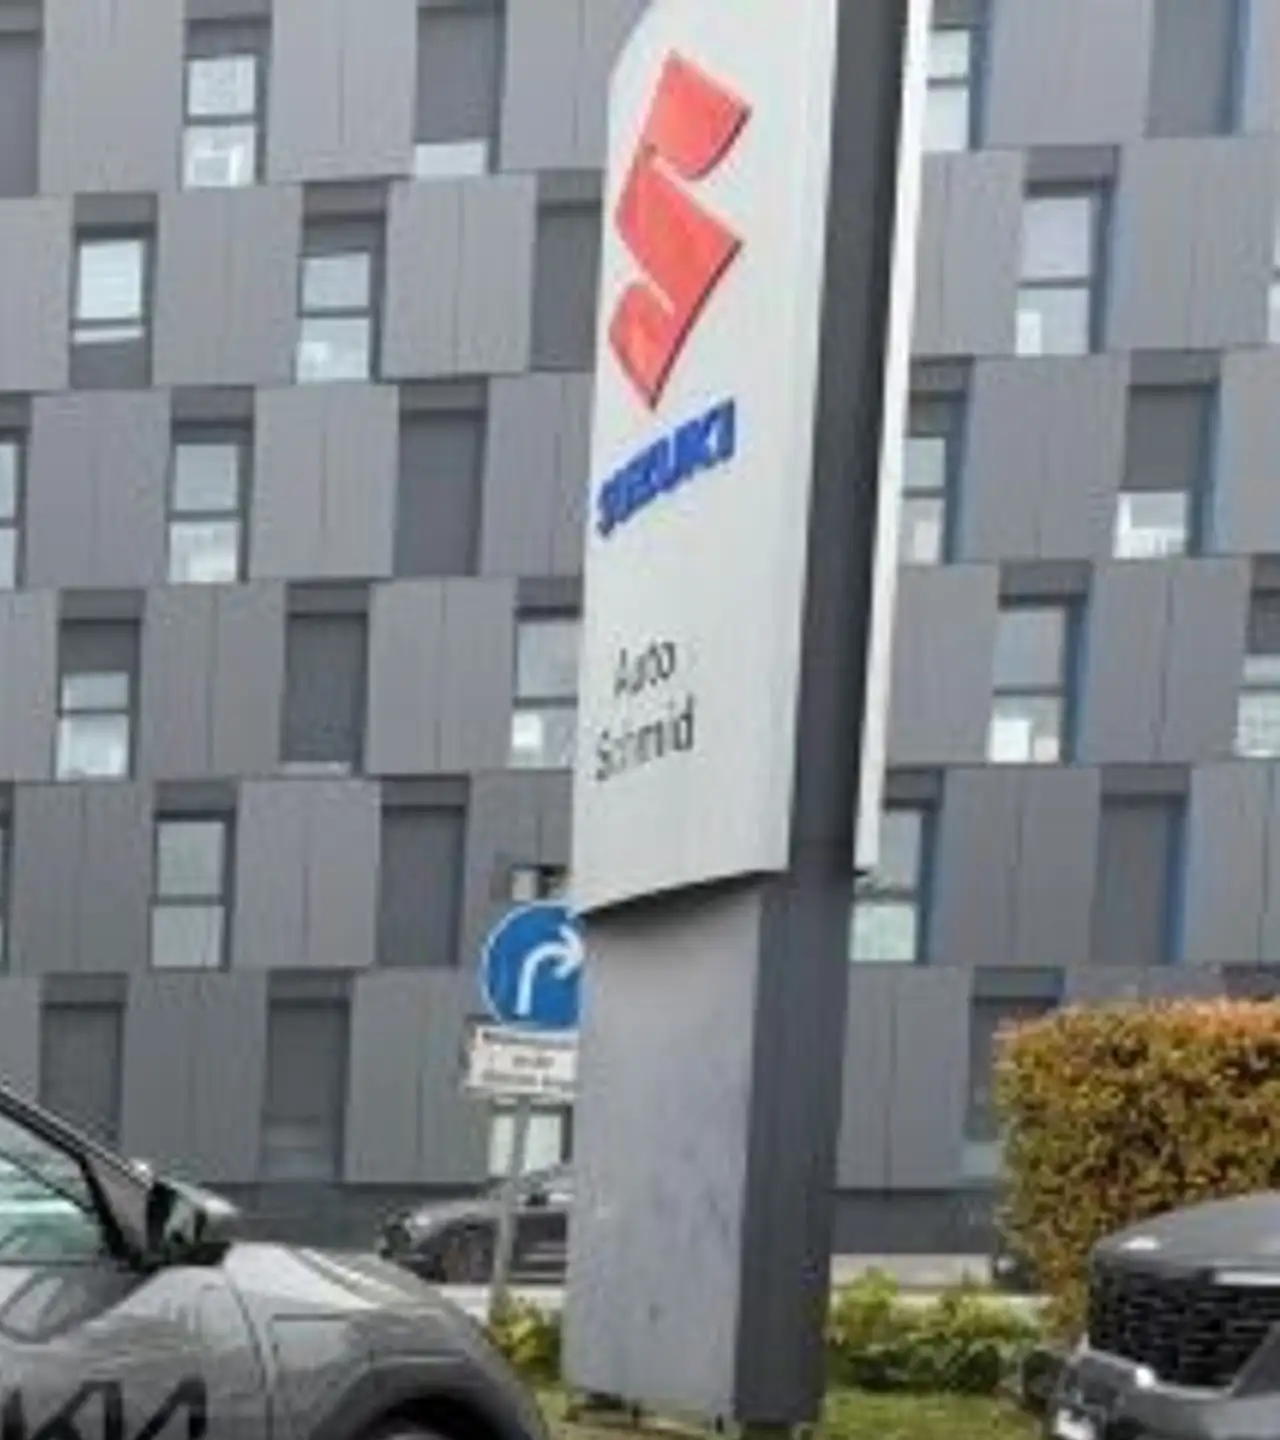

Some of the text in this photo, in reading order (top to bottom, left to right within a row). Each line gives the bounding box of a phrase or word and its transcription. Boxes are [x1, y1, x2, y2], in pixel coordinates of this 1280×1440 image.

[595, 398, 738, 538] SUZUKI
[613, 641, 679, 699] Auto
[594, 694, 697, 781] Schmid
